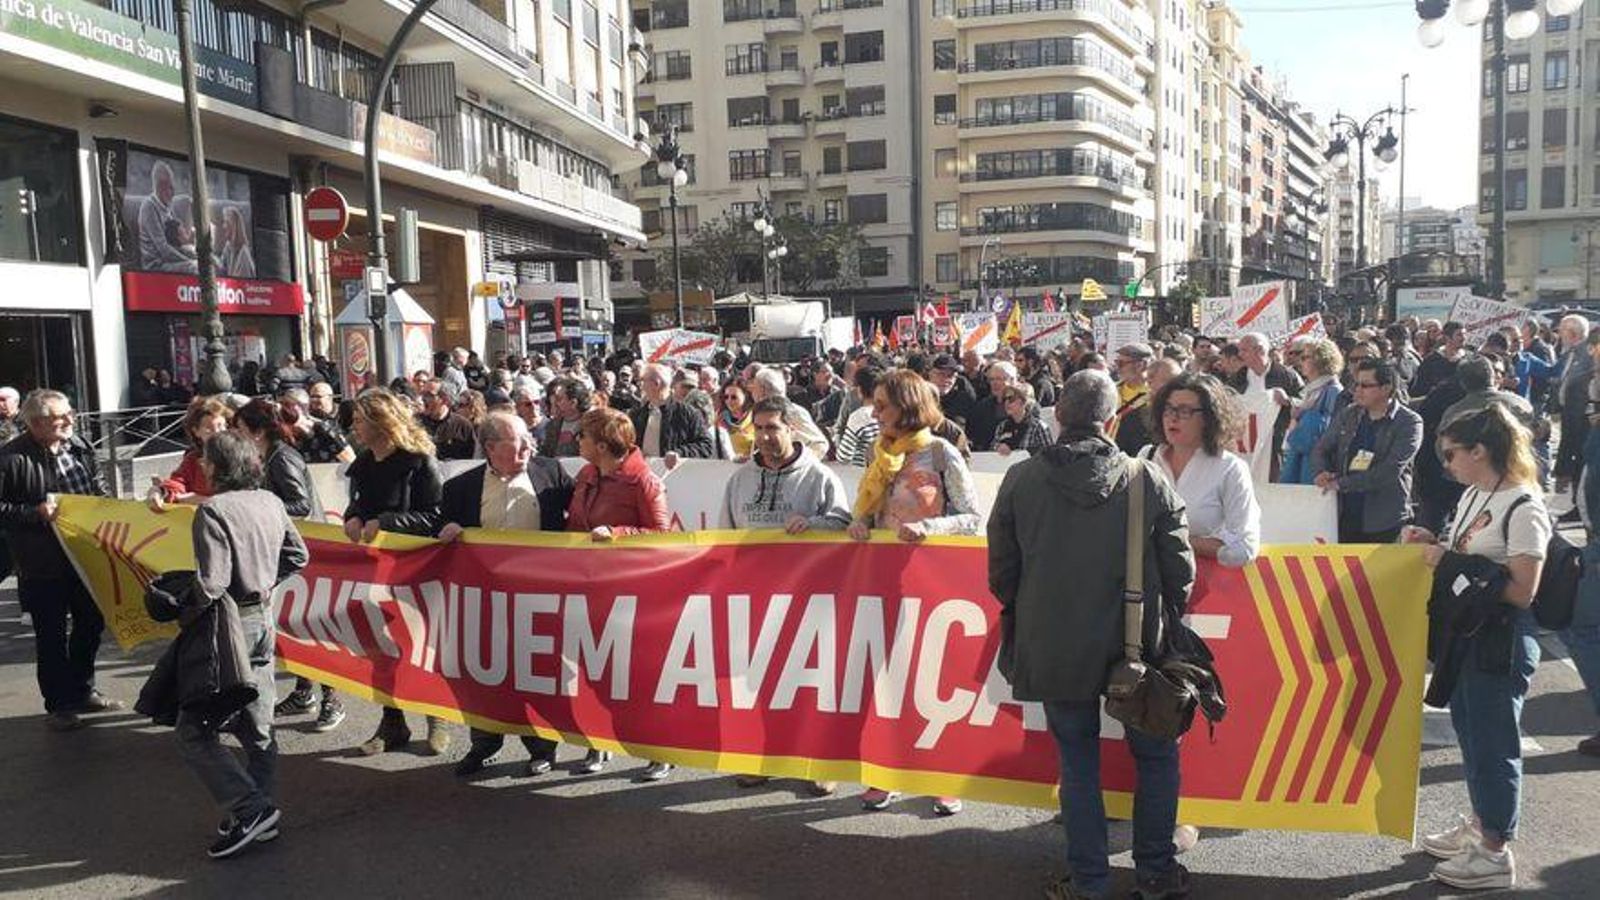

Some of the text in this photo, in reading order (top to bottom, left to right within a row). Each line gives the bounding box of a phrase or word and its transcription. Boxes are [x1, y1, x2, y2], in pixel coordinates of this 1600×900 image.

[41, 4, 65, 29] de
[66, 11, 135, 54] Valencia
[137, 38, 163, 64] San
[273, 574, 637, 701] ONTINUEM
